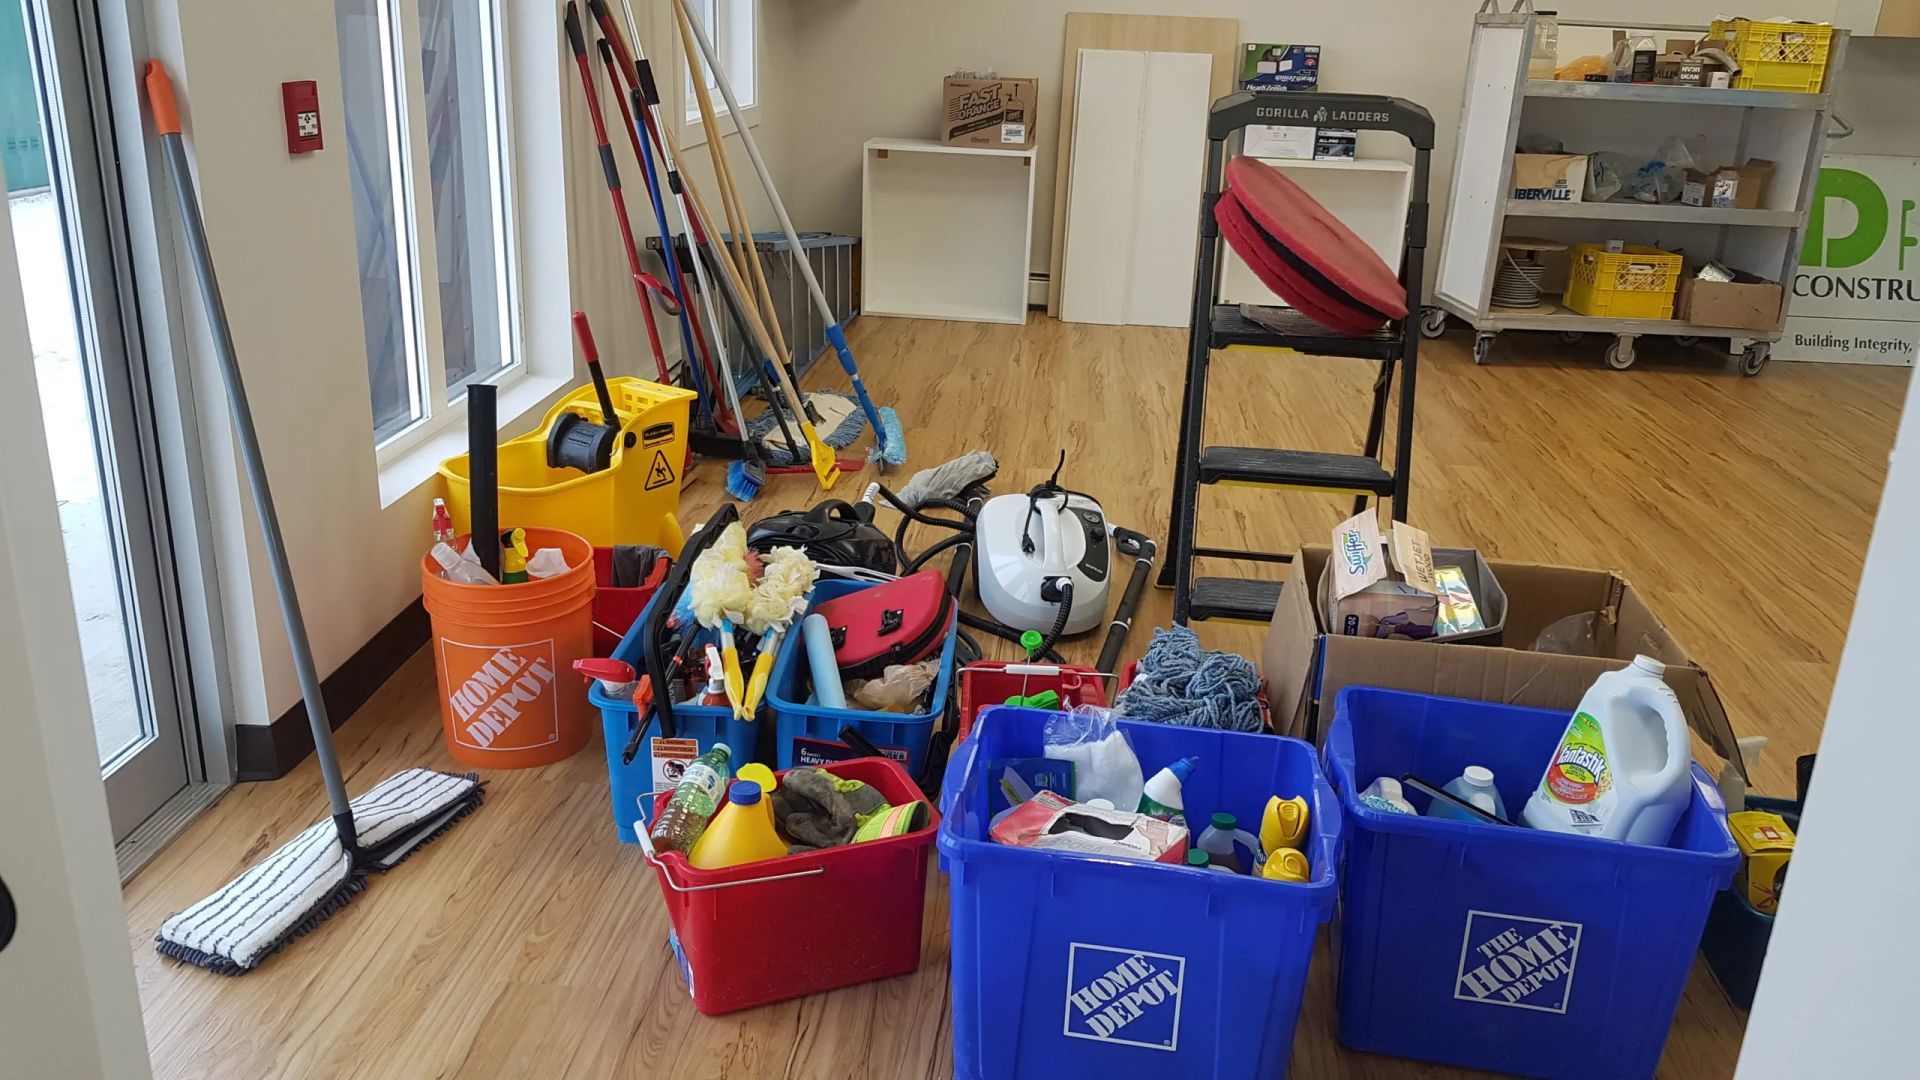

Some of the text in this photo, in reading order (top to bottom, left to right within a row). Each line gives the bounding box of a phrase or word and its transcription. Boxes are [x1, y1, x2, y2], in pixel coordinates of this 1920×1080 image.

[959, 82, 1003, 110] FAST
[959, 99, 1002, 120] ORANGE
[1256, 107, 1390, 122] GORILLA LADDERS
[1514, 188, 1572, 201] IBERVILLE
[1792, 273, 1920, 302] CONSTRU
[1794, 334, 1913, 354] Building Integrity,
[1348, 530, 1369, 576] Swiffer
[1411, 539, 1428, 584] WETJET
[450, 647, 528, 722] HOME
[465, 657, 554, 748] DEPOT
[800, 747, 807, 756] 6
[800, 755, 825, 765] HEAVY
[1476, 927, 1524, 959] THE
[1460, 923, 1576, 999] HOME
[1070, 953, 1156, 1016] HOME
[1500, 956, 1570, 1003] DEPOT
[1085, 969, 1178, 1038] DEPOT
